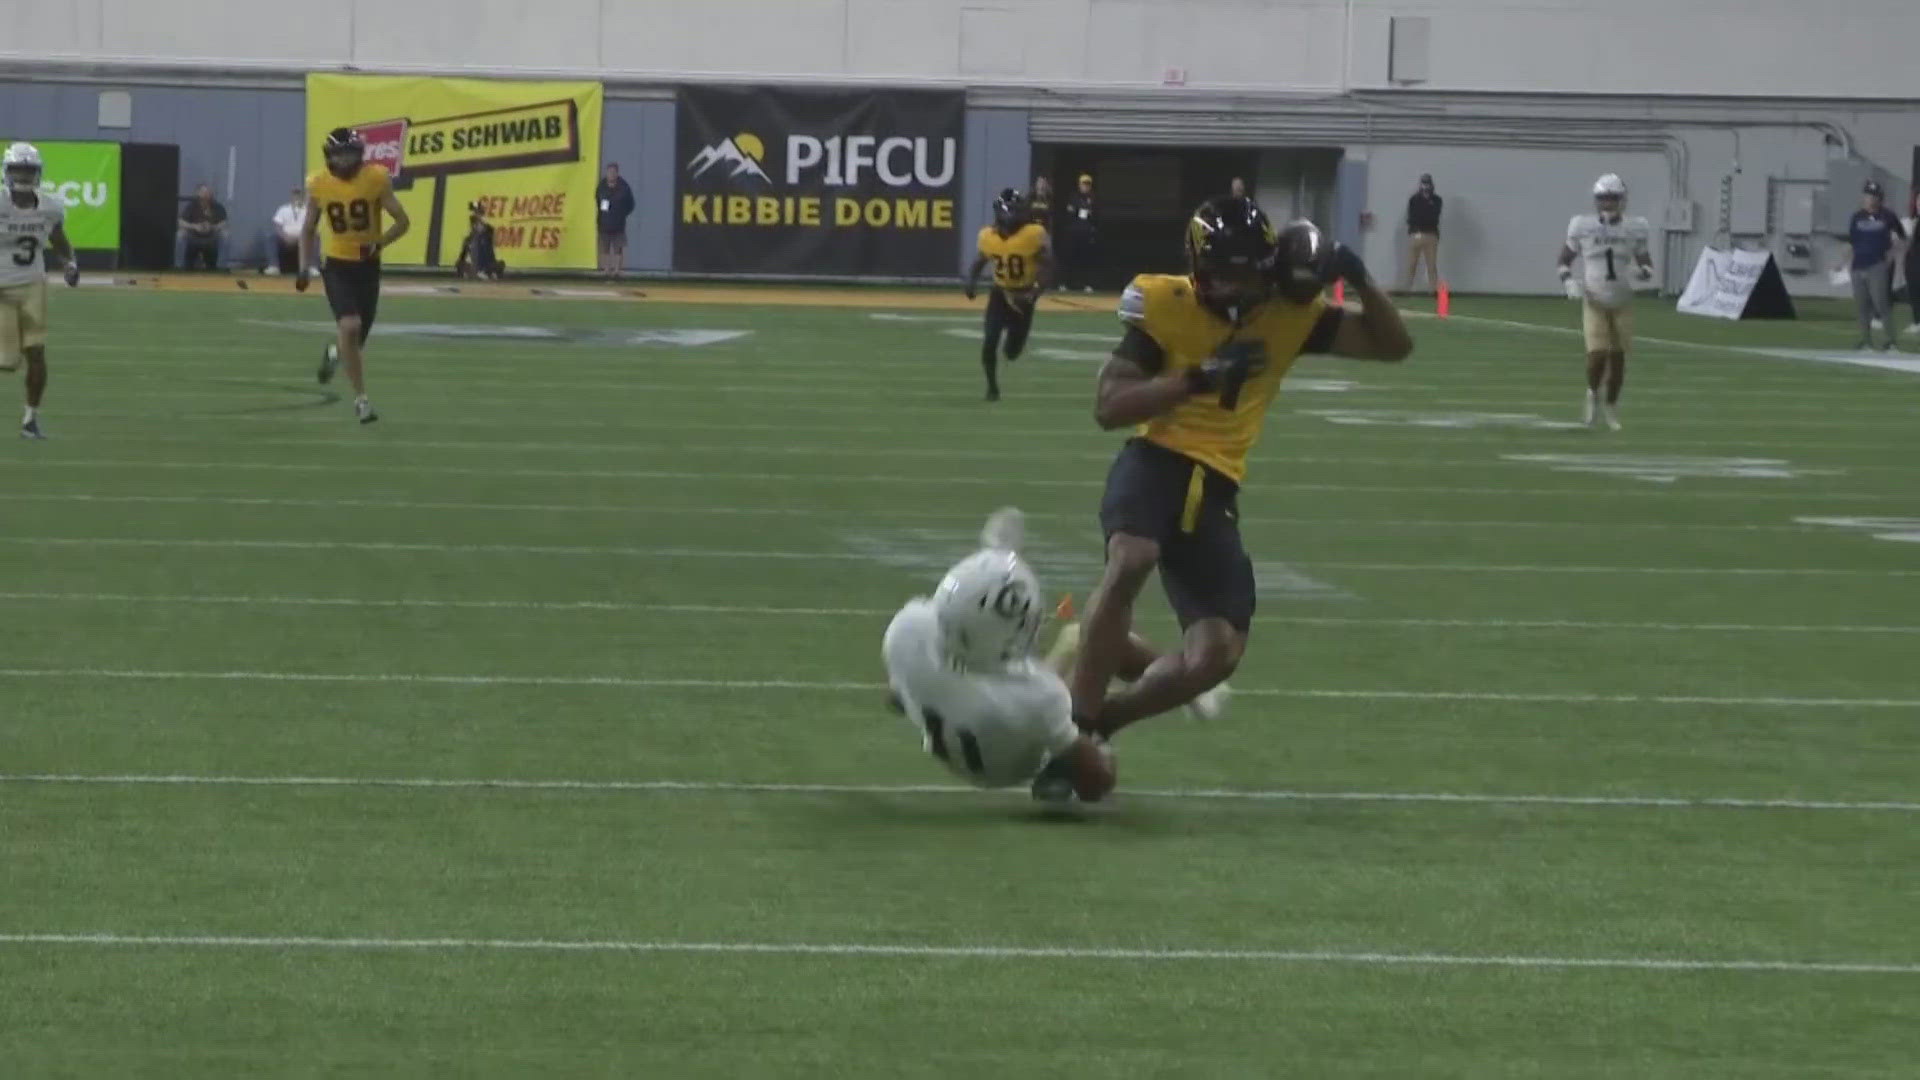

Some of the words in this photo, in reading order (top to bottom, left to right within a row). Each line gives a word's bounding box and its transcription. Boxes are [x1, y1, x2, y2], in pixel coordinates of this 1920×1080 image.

[409, 131, 444, 155] LES
[452, 115, 562, 151] SCHWAB
[786, 134, 956, 187] P1FCU
[327, 198, 370, 233] 89
[510, 192, 565, 216] MORE
[682, 194, 821, 225] KIBBIE
[835, 198, 953, 228] DOME
[12, 235, 39, 267] 3
[528, 226, 560, 249] LES
[1604, 246, 1617, 281] 1
